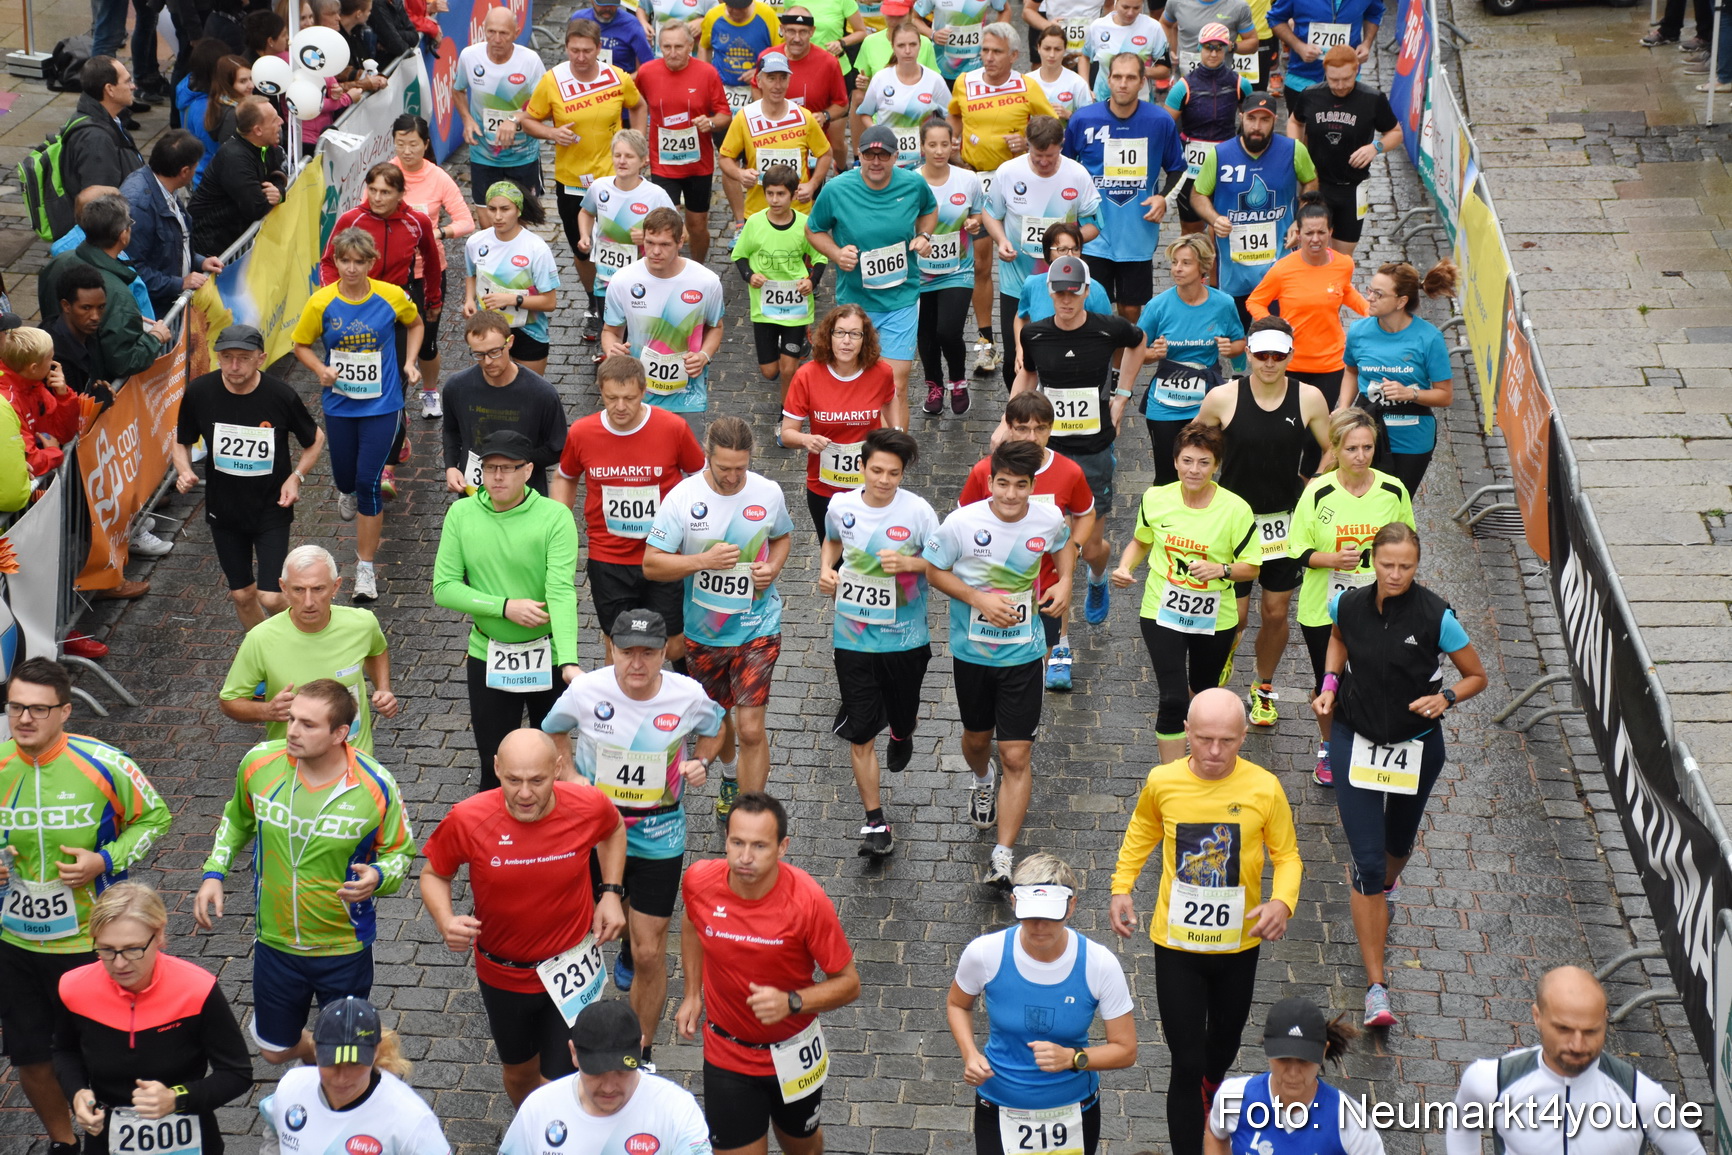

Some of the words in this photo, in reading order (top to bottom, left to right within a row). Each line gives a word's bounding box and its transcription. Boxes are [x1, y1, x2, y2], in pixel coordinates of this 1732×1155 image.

[949, 33, 979, 46] 2443
[1312, 32, 1346, 46] 2706
[565, 101, 594, 113] MAX
[596, 90, 624, 104] BÖGL
[968, 101, 994, 112] MAX
[998, 96, 1029, 106] BÖGL
[1315, 111, 1357, 125] FLORIDA
[753, 135, 778, 148] MAX
[780, 128, 807, 142] BÖGL
[1084, 125, 1110, 144] 14
[662, 136, 696, 151] 2249
[1118, 149, 1136, 165] 10
[1220, 165, 1246, 182] 21
[1229, 207, 1287, 221] FIBALON
[1240, 233, 1268, 250] 194
[600, 249, 632, 266] 2591
[926, 242, 957, 260] 334
[867, 253, 905, 276] 3066
[928, 261, 951, 269] Tamara
[766, 290, 803, 305] 2643
[779, 307, 790, 315] Jan
[336, 362, 377, 381] 2558
[649, 361, 679, 380] 202
[1361, 365, 1414, 373] www.hasit.de
[343, 384, 367, 393] Sandra
[651, 380, 673, 390] Tobias
[814, 410, 871, 421] NEUMARKT
[1056, 400, 1089, 418] 312
[1061, 422, 1084, 430] Marco
[220, 436, 269, 459] 2279
[233, 461, 254, 471] Hans
[589, 466, 651, 478] NEUMARKT
[833, 474, 859, 483] Kerstin
[609, 500, 656, 518] 2604
[743, 508, 765, 519] Hervis
[622, 523, 643, 532] Anton
[889, 528, 908, 539] Hervis
[1262, 520, 1286, 541] 88
[1165, 533, 1209, 552] Müller
[699, 571, 749, 595] 3059
[842, 582, 891, 606] 2735
[1166, 590, 1215, 615] 2528
[859, 608, 870, 617] Ali
[1179, 616, 1194, 626] Rita
[980, 627, 1000, 637] Amir
[1002, 628, 1021, 637] Reza
[494, 648, 545, 671] 2617
[501, 675, 537, 685] Thorsten
[593, 722, 614, 731] PARTL
[656, 717, 679, 728] Hervis
[1367, 745, 1408, 769] 174
[617, 764, 645, 785] 44
[1377, 772, 1390, 783] Evi
[614, 789, 643, 800] Lothar
[0, 803, 96, 830] BOCK
[504, 856, 536, 866] Amberger
[537, 851, 576, 863] Kaolinwerke
[9, 891, 68, 919] 2835
[1183, 901, 1230, 927] 226
[715, 930, 746, 942] Amberger
[747, 935, 784, 946] Kaolinwerke
[1187, 931, 1222, 943] Roland
[552, 944, 602, 999] 2313
[799, 1036, 822, 1070] 90
[119, 1118, 193, 1152] 2600
[281, 1131, 300, 1146] PARTL
[1018, 1122, 1068, 1150] 219
[349, 1138, 380, 1154] Hervis
[629, 1138, 656, 1152] Hervis
